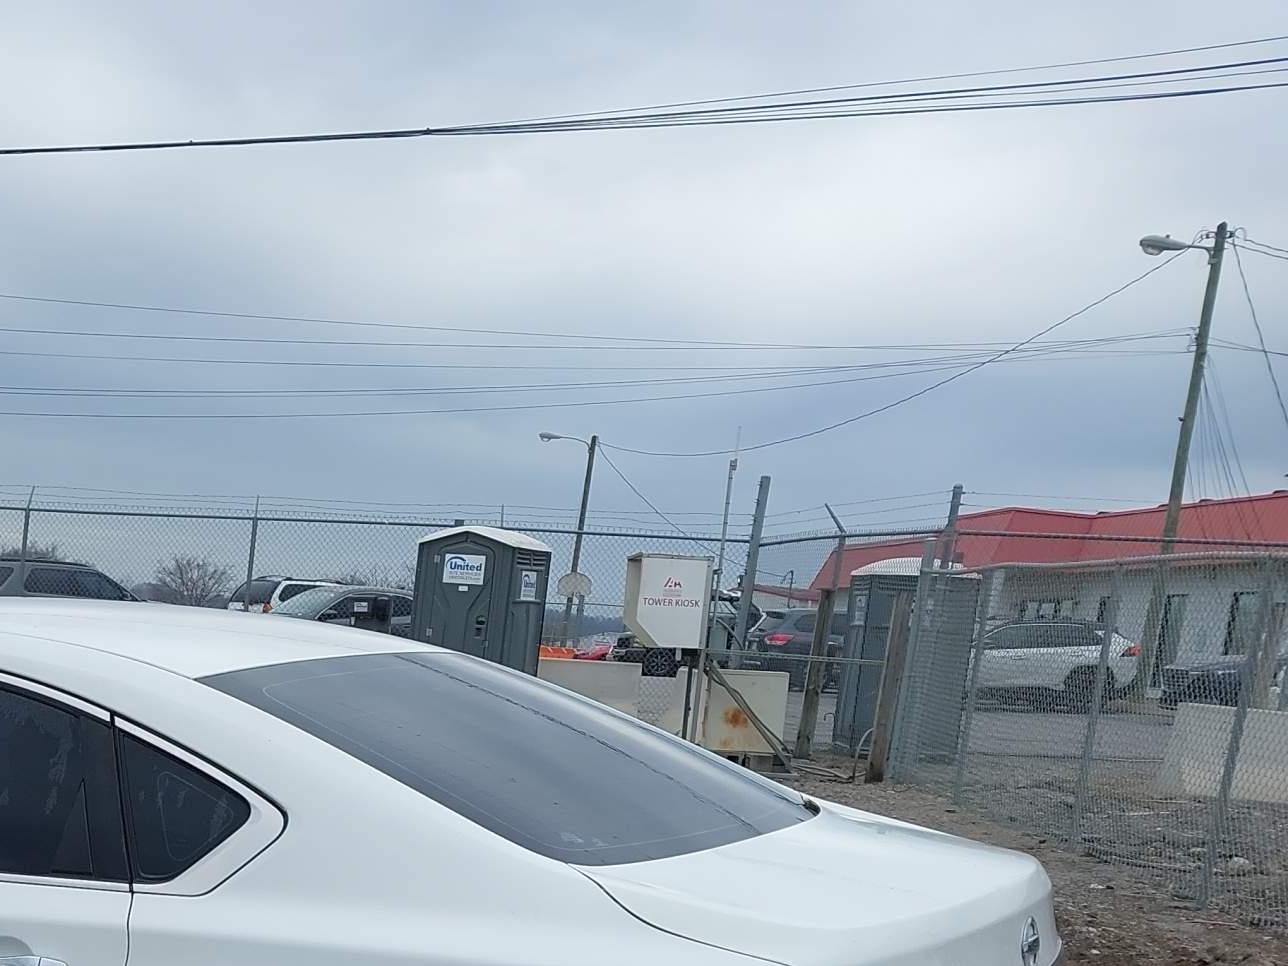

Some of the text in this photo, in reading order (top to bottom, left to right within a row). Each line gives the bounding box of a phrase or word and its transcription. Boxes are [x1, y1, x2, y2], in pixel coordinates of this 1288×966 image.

[450, 561, 482, 571] United
[643, 597, 700, 608] TOWER KIOSK
